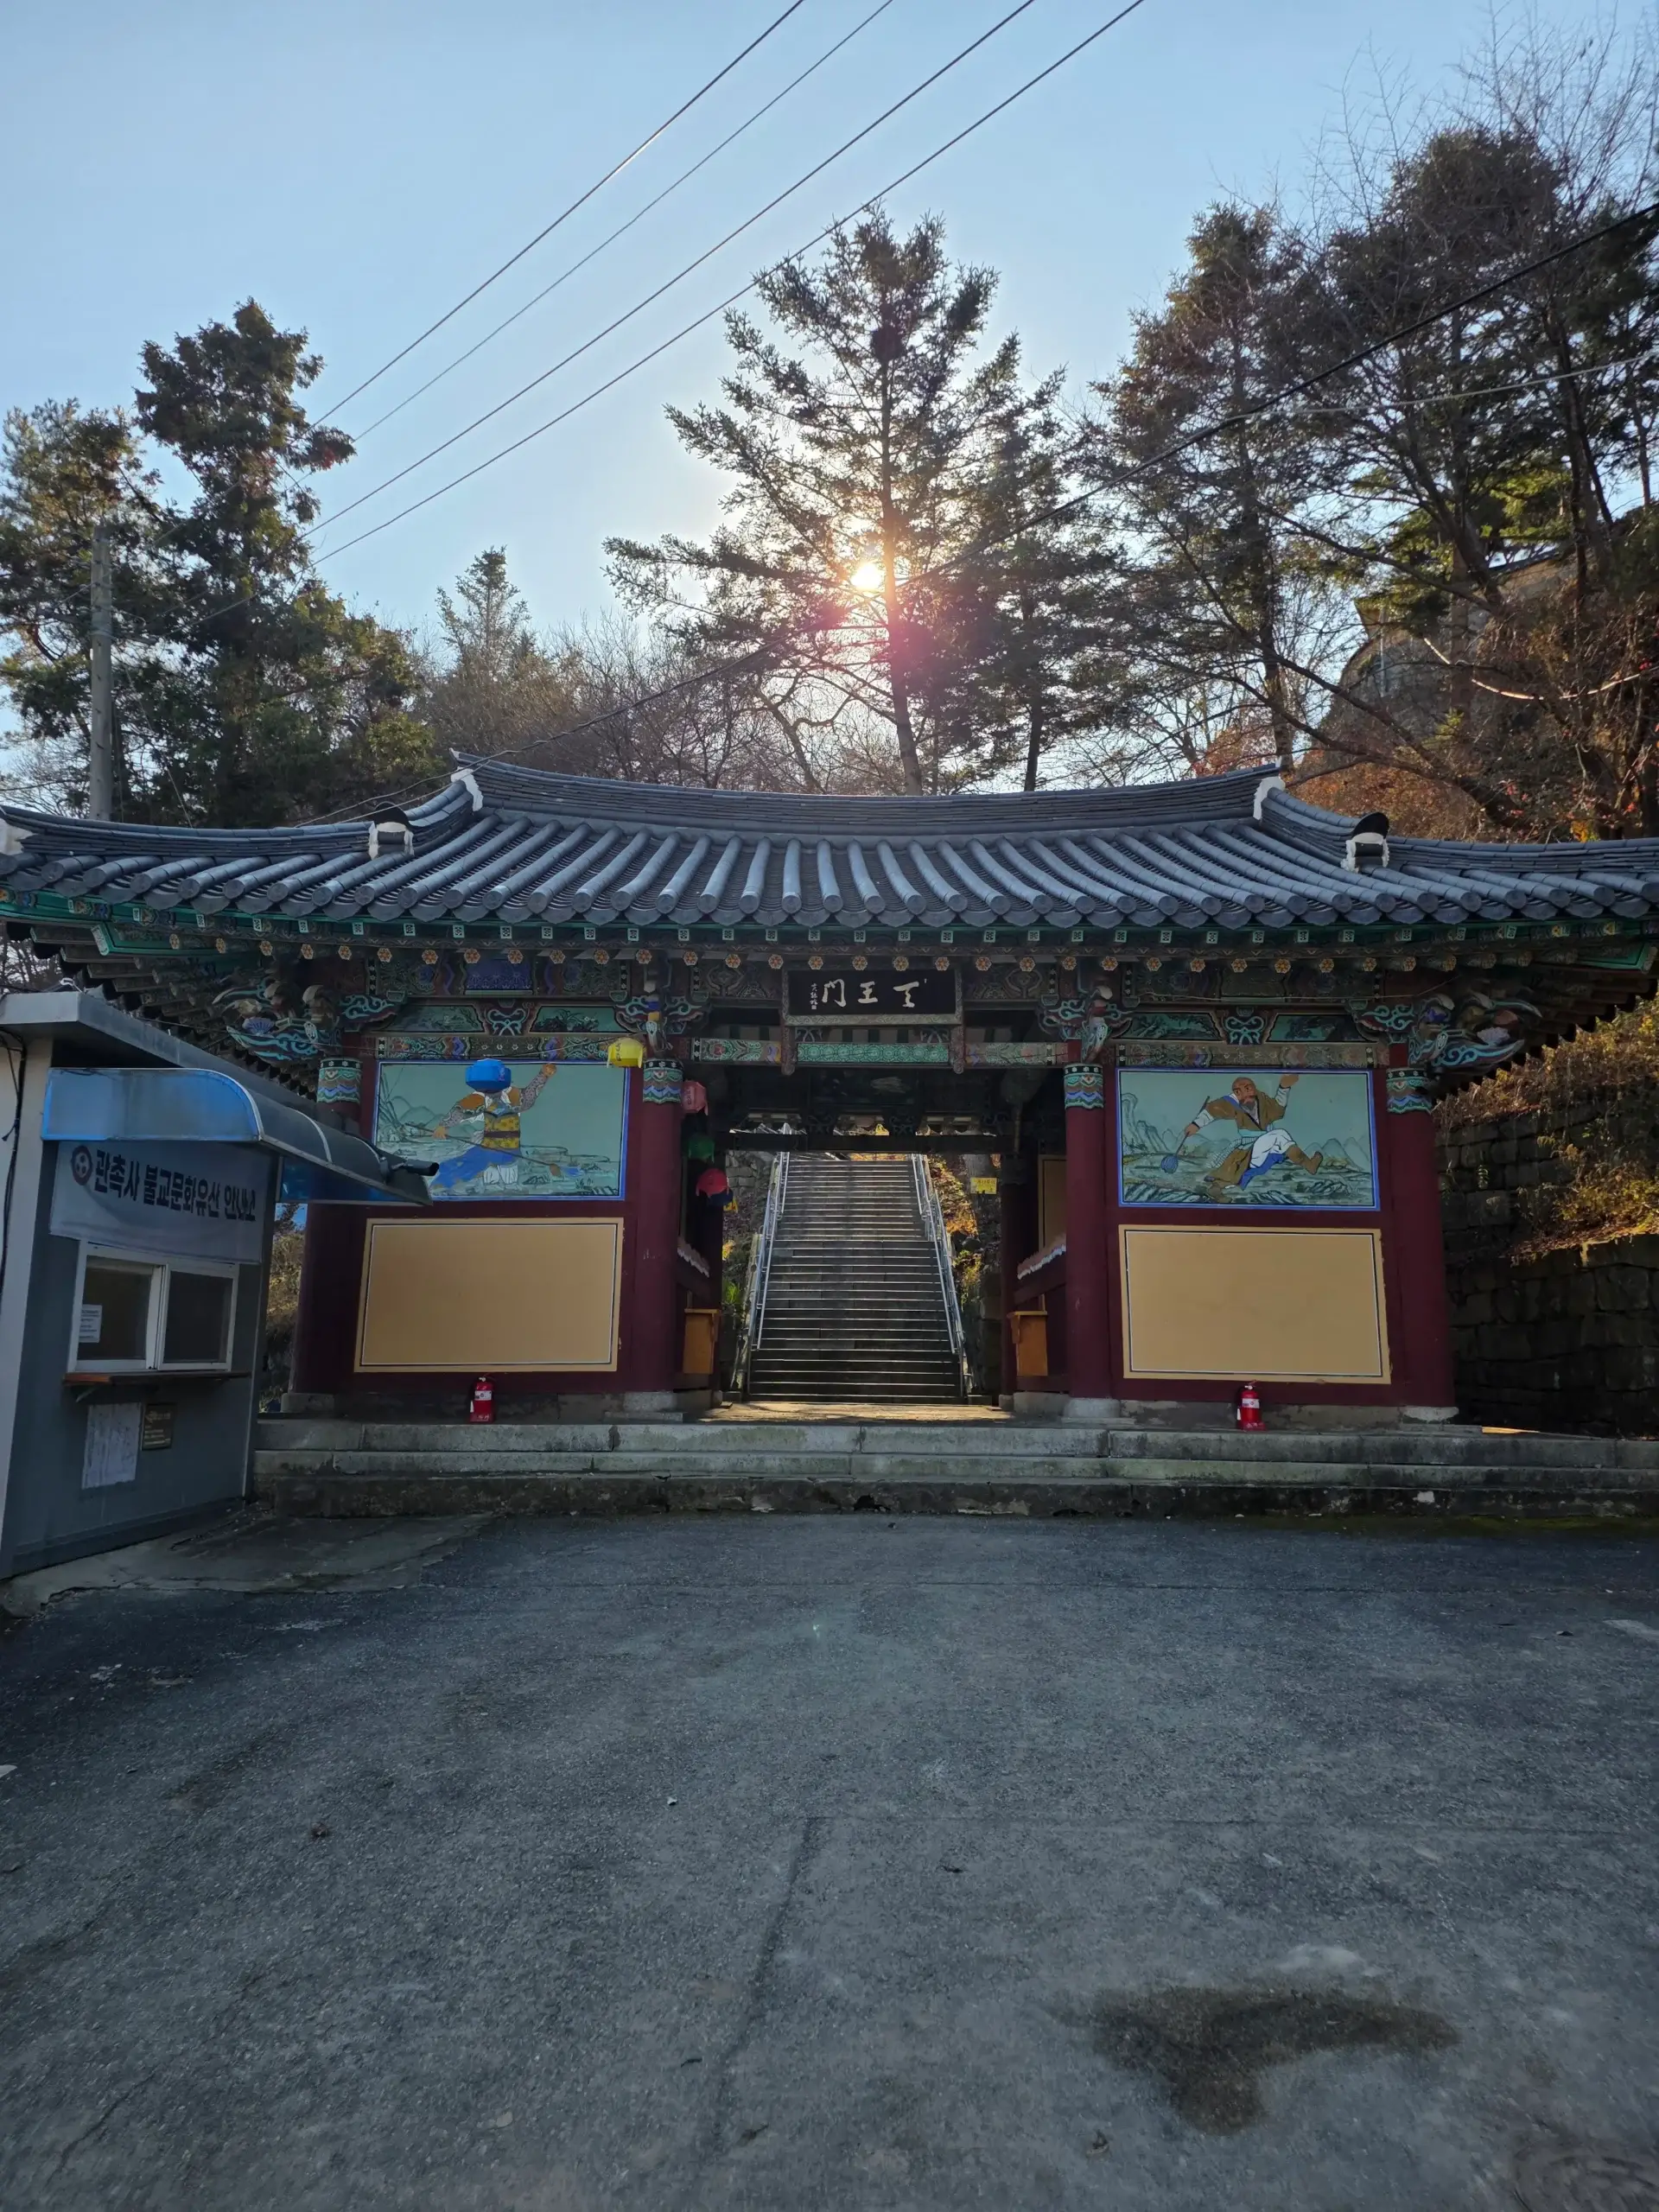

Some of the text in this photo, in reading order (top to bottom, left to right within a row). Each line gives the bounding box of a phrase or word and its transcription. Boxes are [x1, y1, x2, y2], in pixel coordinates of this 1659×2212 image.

[94, 1149, 256, 1222] 관촉사 불교문화유산 안내소
